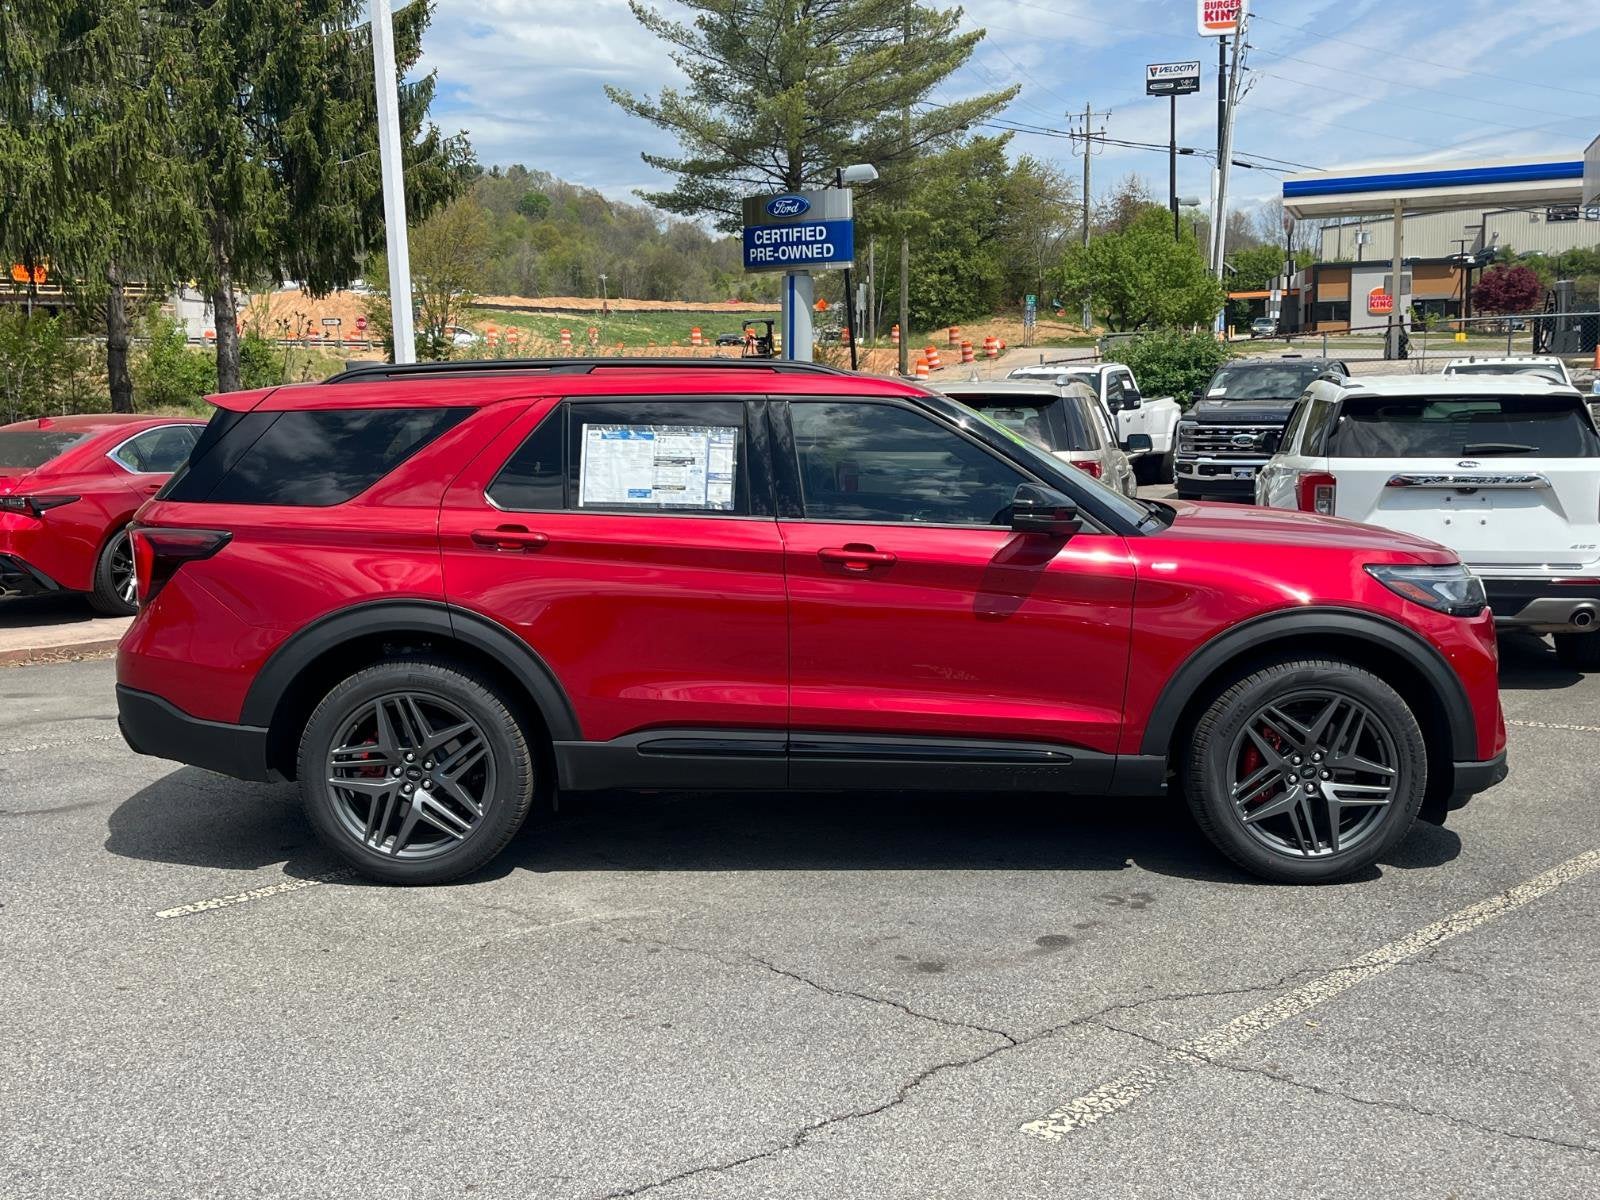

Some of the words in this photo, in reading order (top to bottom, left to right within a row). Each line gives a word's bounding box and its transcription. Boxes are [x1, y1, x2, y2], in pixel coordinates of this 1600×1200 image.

[1204, 0, 1241, 10] BURGER
[1159, 64, 1197, 73] VELOCITY
[773, 200, 800, 215] Ford
[754, 226, 827, 244] CERTIFIED
[749, 243, 834, 261] PRE-OWNED
